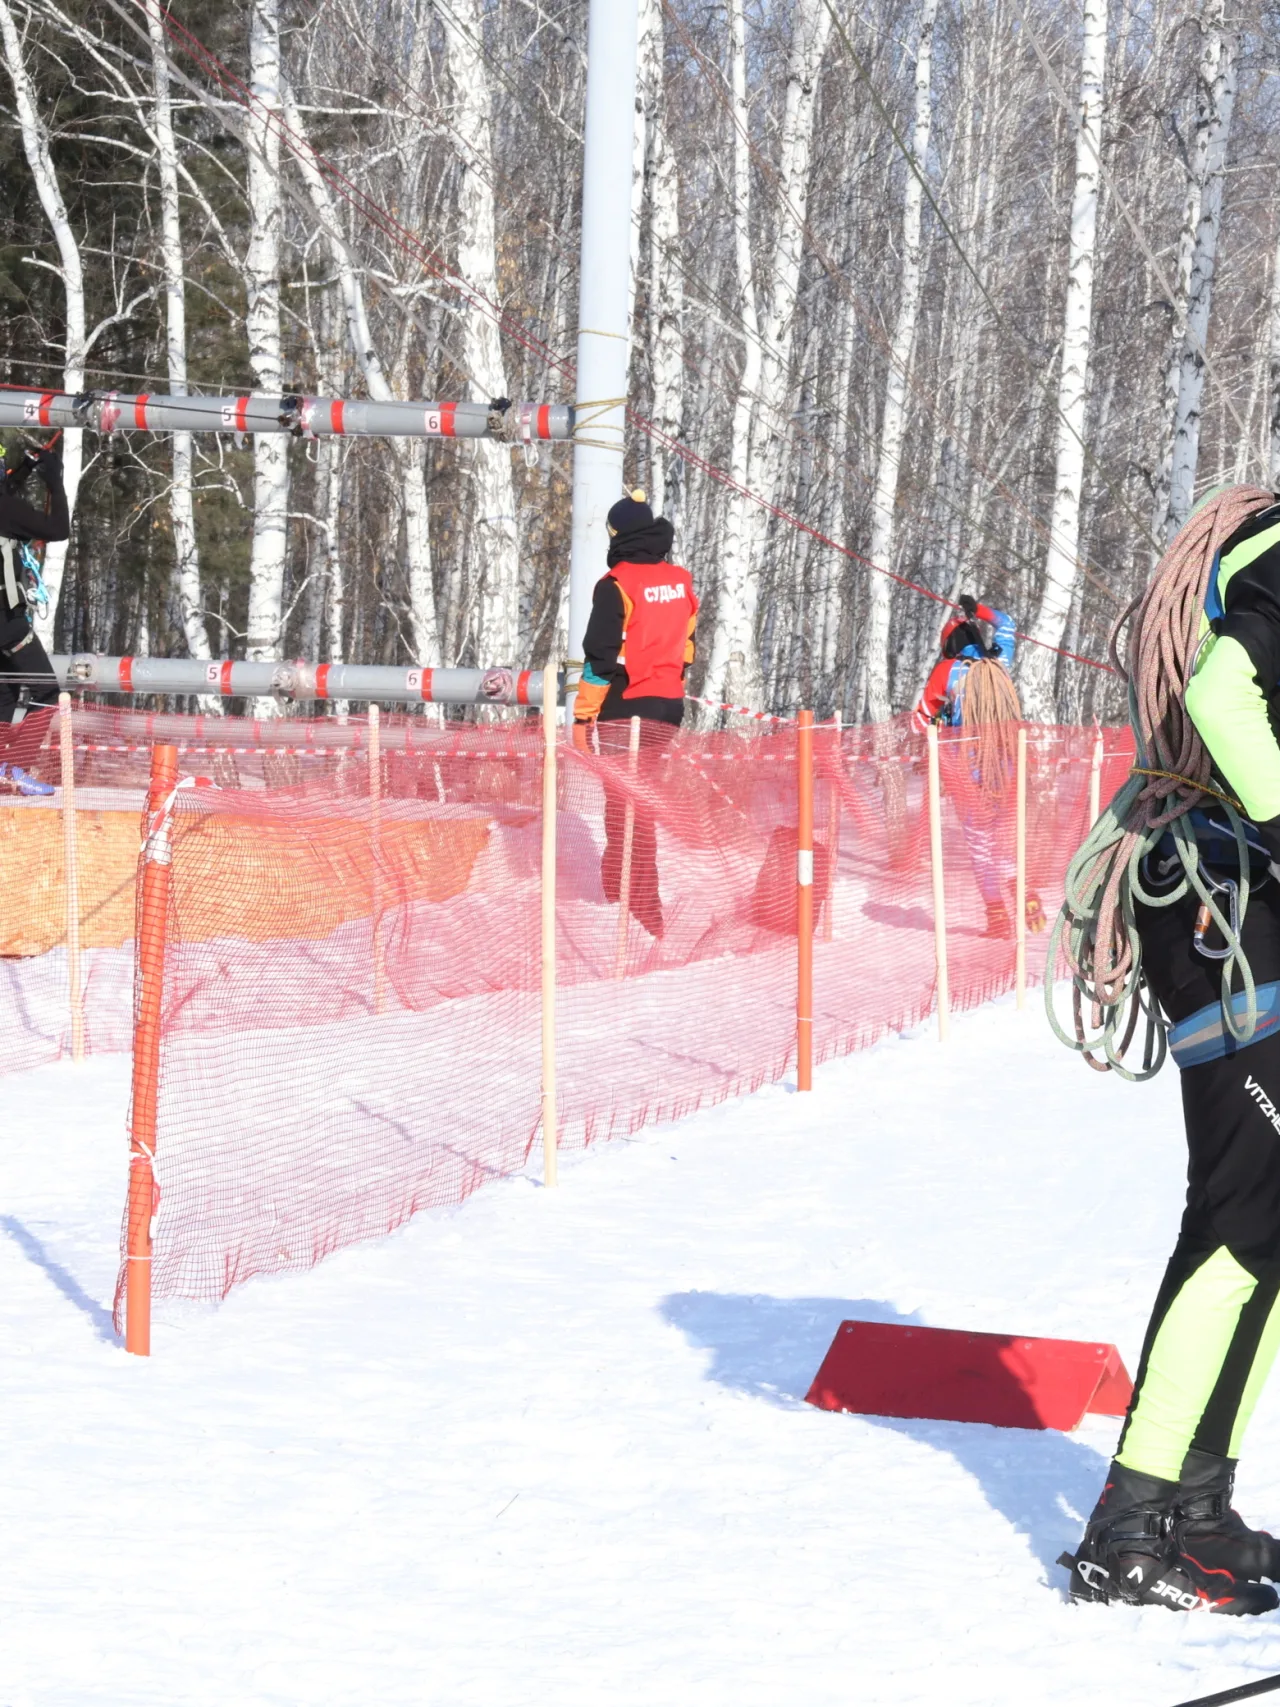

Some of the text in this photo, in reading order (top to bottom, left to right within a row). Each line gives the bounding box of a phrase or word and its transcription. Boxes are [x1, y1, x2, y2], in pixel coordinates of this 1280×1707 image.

[25, 404, 35, 416] 4
[223, 408, 232, 422] 5
[428, 415, 438, 430] 6
[643, 583, 686, 604] СУДЬЯ
[208, 666, 218, 680] 5
[408, 672, 418, 686] 6
